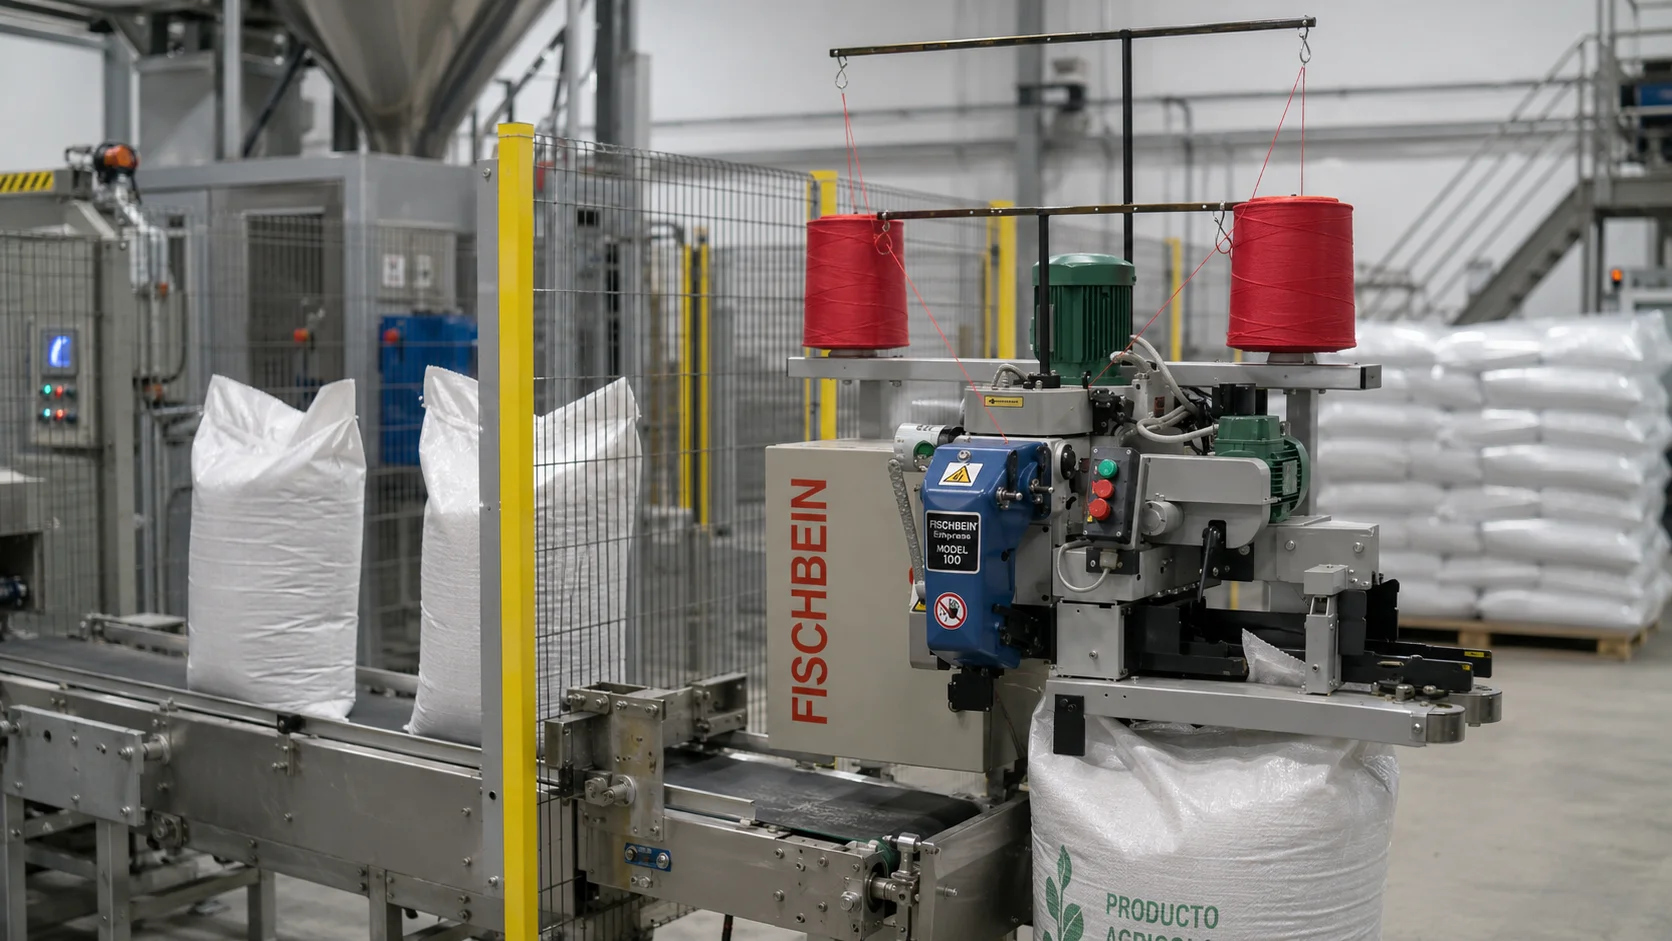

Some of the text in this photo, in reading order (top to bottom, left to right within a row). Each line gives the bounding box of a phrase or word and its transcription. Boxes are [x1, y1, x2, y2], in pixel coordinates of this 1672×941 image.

[936, 544, 968, 555] MODEL
[943, 554, 961, 565] 100
[791, 478, 828, 724] FISCHBEIN
[1106, 892, 1219, 929] PRODUCTO
